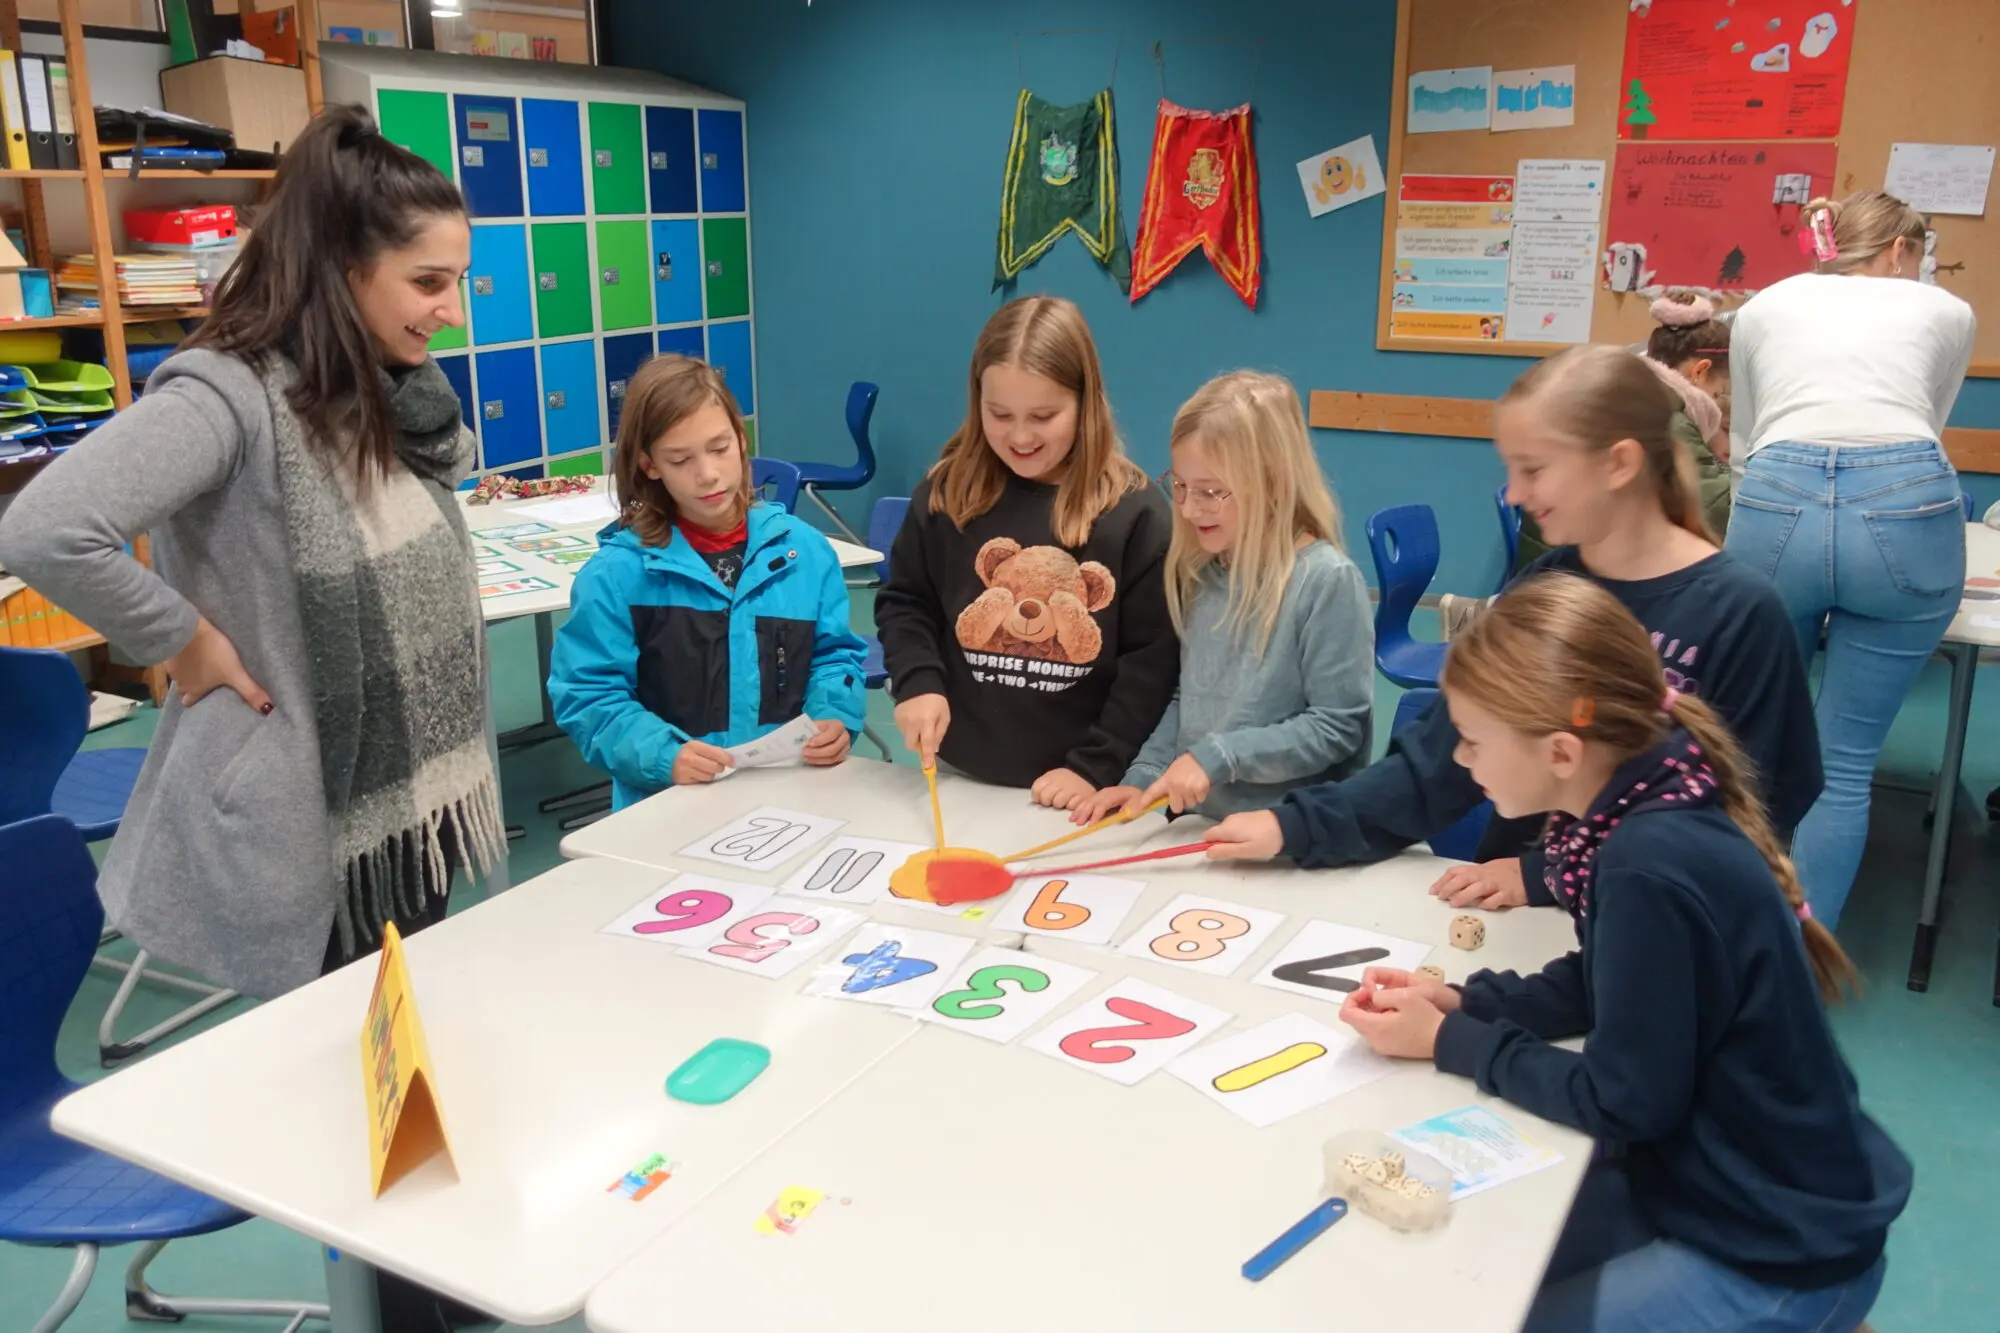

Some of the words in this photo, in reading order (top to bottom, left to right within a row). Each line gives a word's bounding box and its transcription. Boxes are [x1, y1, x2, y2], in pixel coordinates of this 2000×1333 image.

[997, 673, 1026, 688] TWO
[711, 817, 811, 861] 12
[804, 848, 884, 893] 11
[708, 912, 820, 963] 5
[1149, 909, 1251, 962] 8
[841, 940, 938, 993] 4
[932, 965, 1051, 1020] 3
[1059, 997, 1197, 1063] 2
[1212, 1042, 1328, 1093] 1
